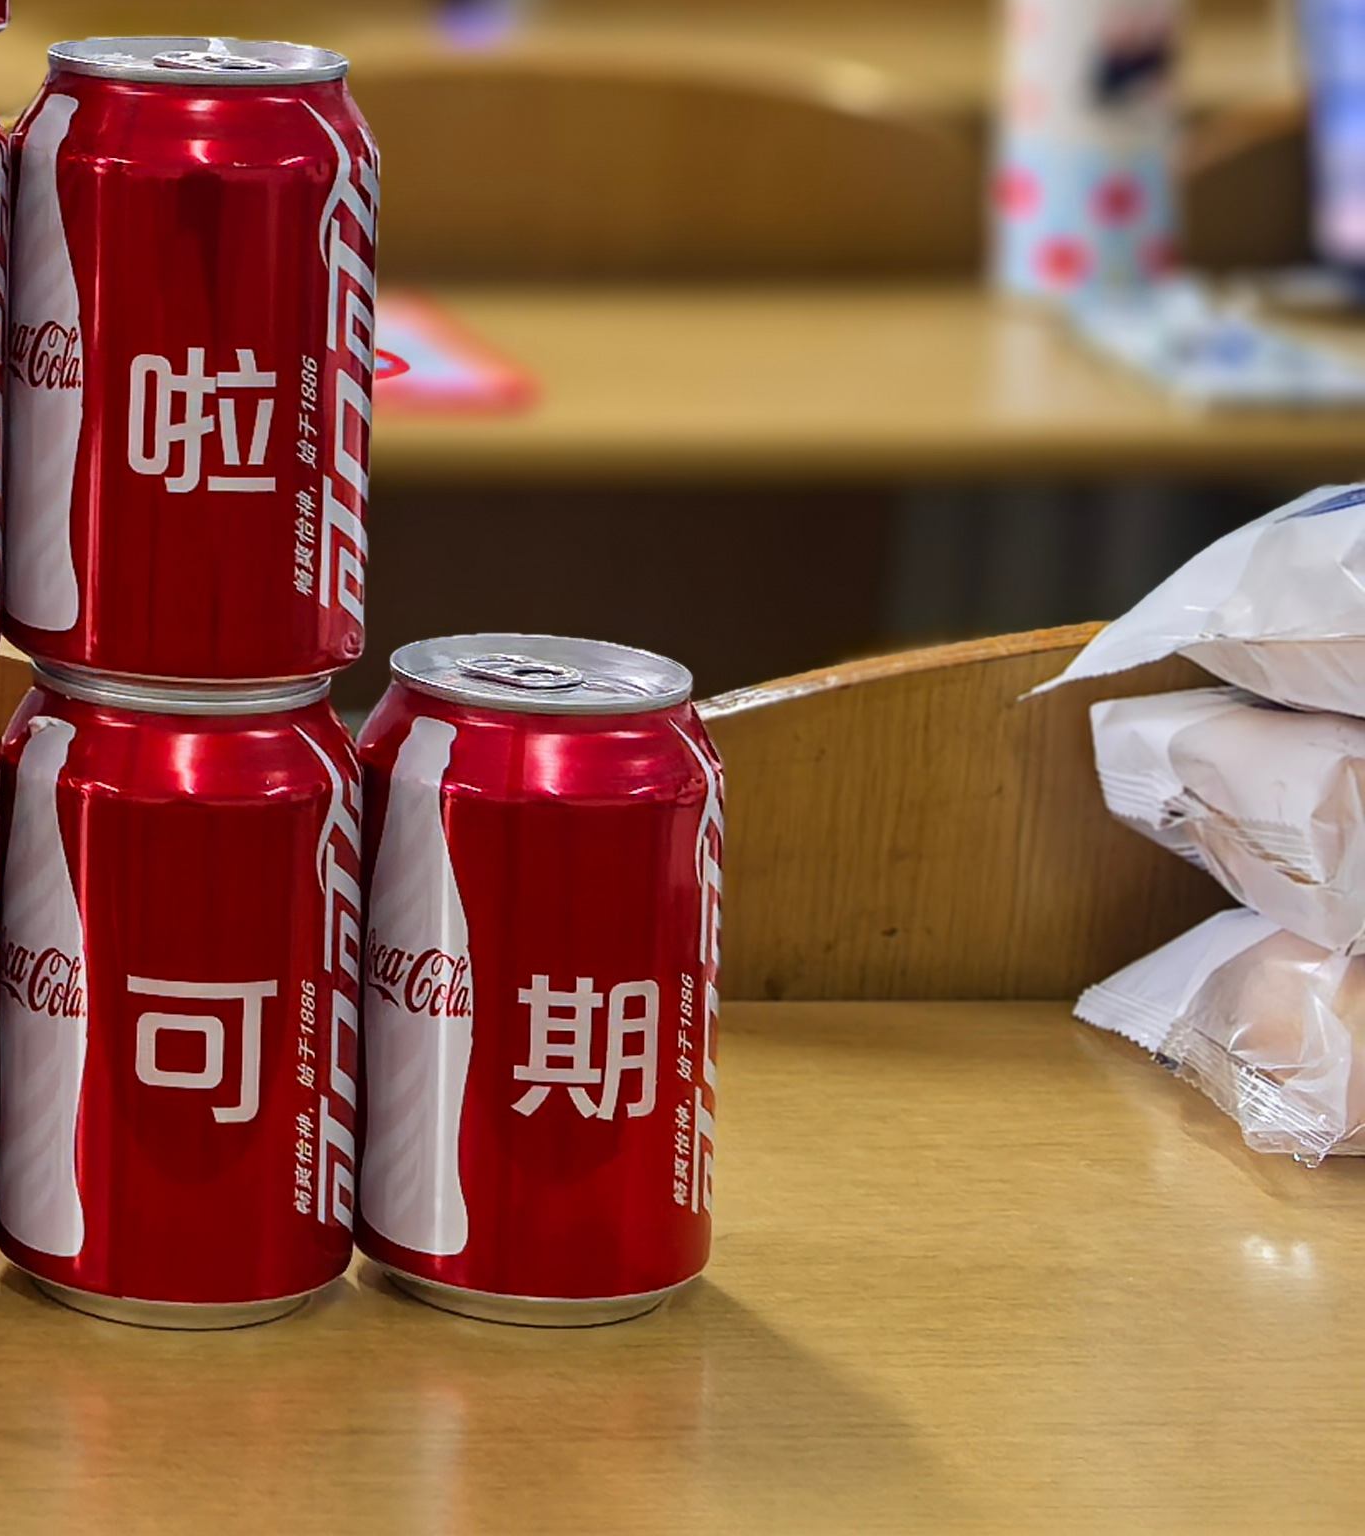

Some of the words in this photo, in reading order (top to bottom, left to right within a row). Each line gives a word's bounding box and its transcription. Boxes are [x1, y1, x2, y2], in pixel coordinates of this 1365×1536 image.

[127, 347, 276, 493] 啦
[127, 974, 278, 1123] 可
[511, 974, 659, 1121] 期
